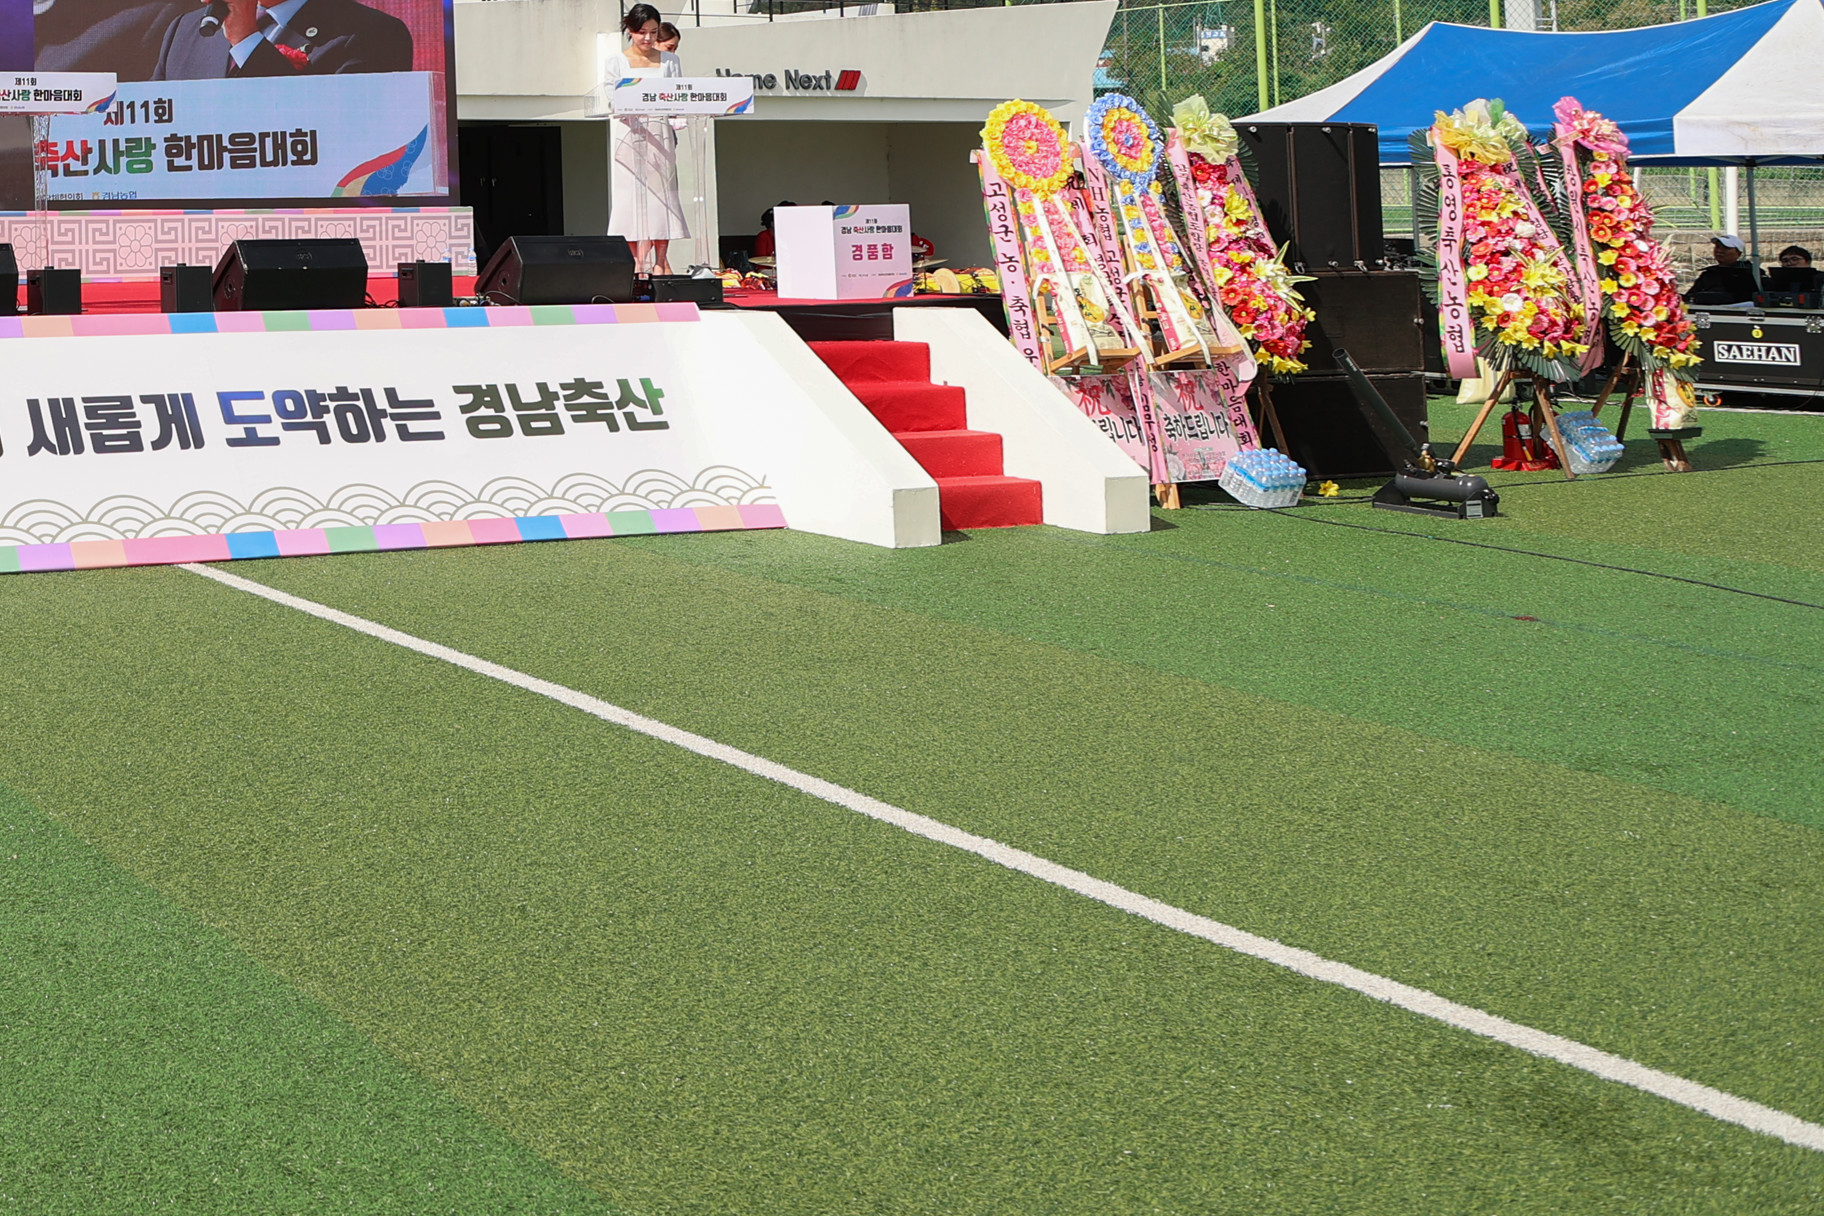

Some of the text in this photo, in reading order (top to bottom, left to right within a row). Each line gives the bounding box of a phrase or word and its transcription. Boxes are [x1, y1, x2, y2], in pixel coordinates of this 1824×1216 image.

[14, 77, 38, 86] 제11회
[784, 69, 832, 91] Next
[33, 88, 83, 102] 한마음대회
[658, 93, 688, 102] 축산사랑
[690, 92, 727, 102] 한마음대회
[35, 127, 319, 178] 축산사랑 한마음대회
[986, 182, 1015, 243] 고성군
[851, 243, 894, 261] 경품함
[1439, 163, 1466, 354] 통영축산농협
[1718, 344, 1796, 362] SAEHAN
[25, 392, 206, 457] 새롭게
[215, 385, 447, 449] 도약하는
[451, 376, 671, 439] 경남축산
[1163, 411, 1231, 442] 축하드립니다
